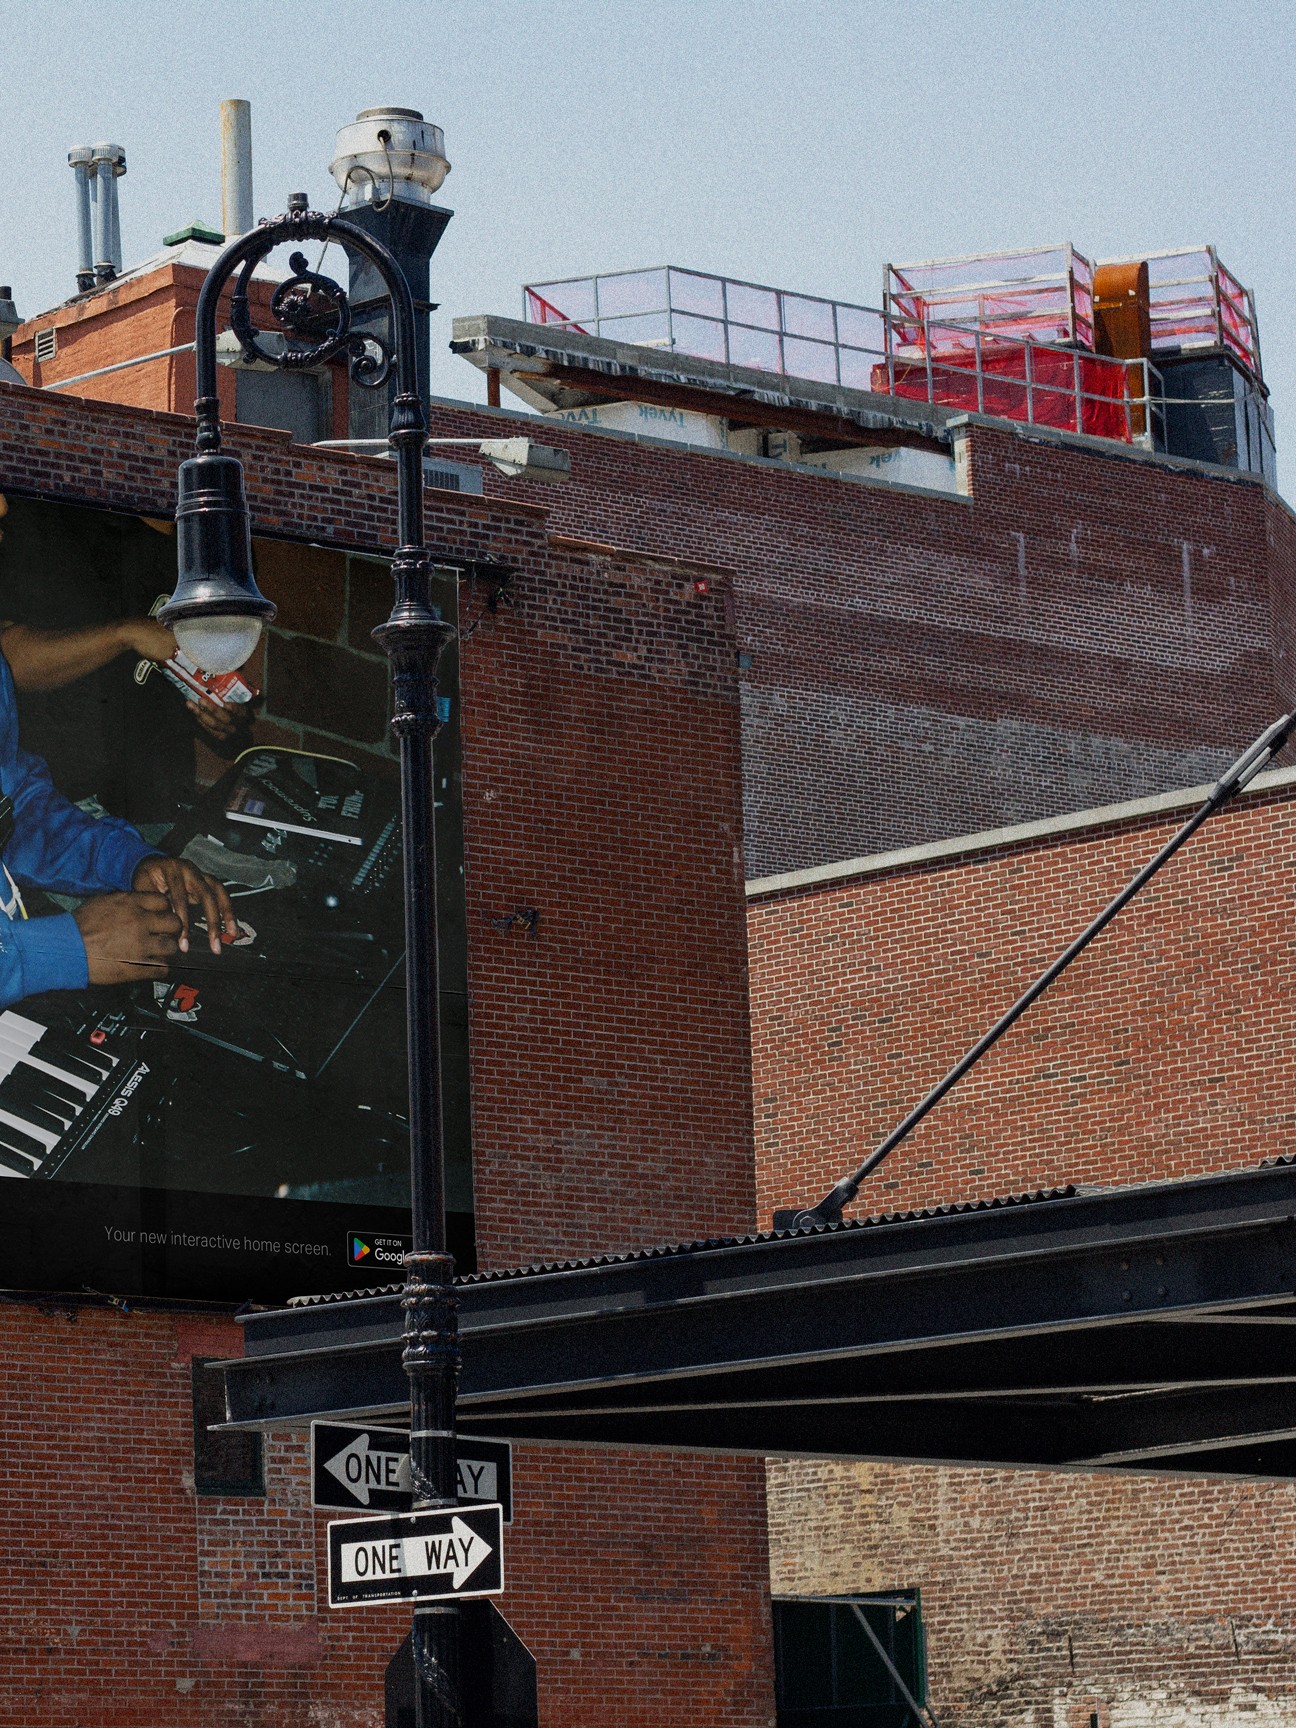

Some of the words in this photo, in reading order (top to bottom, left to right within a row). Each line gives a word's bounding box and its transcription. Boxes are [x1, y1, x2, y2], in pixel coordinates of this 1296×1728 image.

[638, 404, 687, 428] Tyvek
[121, 1062, 150, 1097] ALESIS
[107, 1098, 128, 1116] Q49
[104, 1225, 136, 1242] Your
[140, 1231, 167, 1244] new
[170, 1230, 240, 1250] interactive
[244, 1235, 281, 1253] home
[284, 1242, 331, 1256] screen.
[374, 1248, 405, 1265] Googl
[345, 1453, 400, 1487] ONE
[457, 1463, 485, 1494] AY
[355, 1543, 402, 1576] ONE
[424, 1536, 474, 1571] WAY
